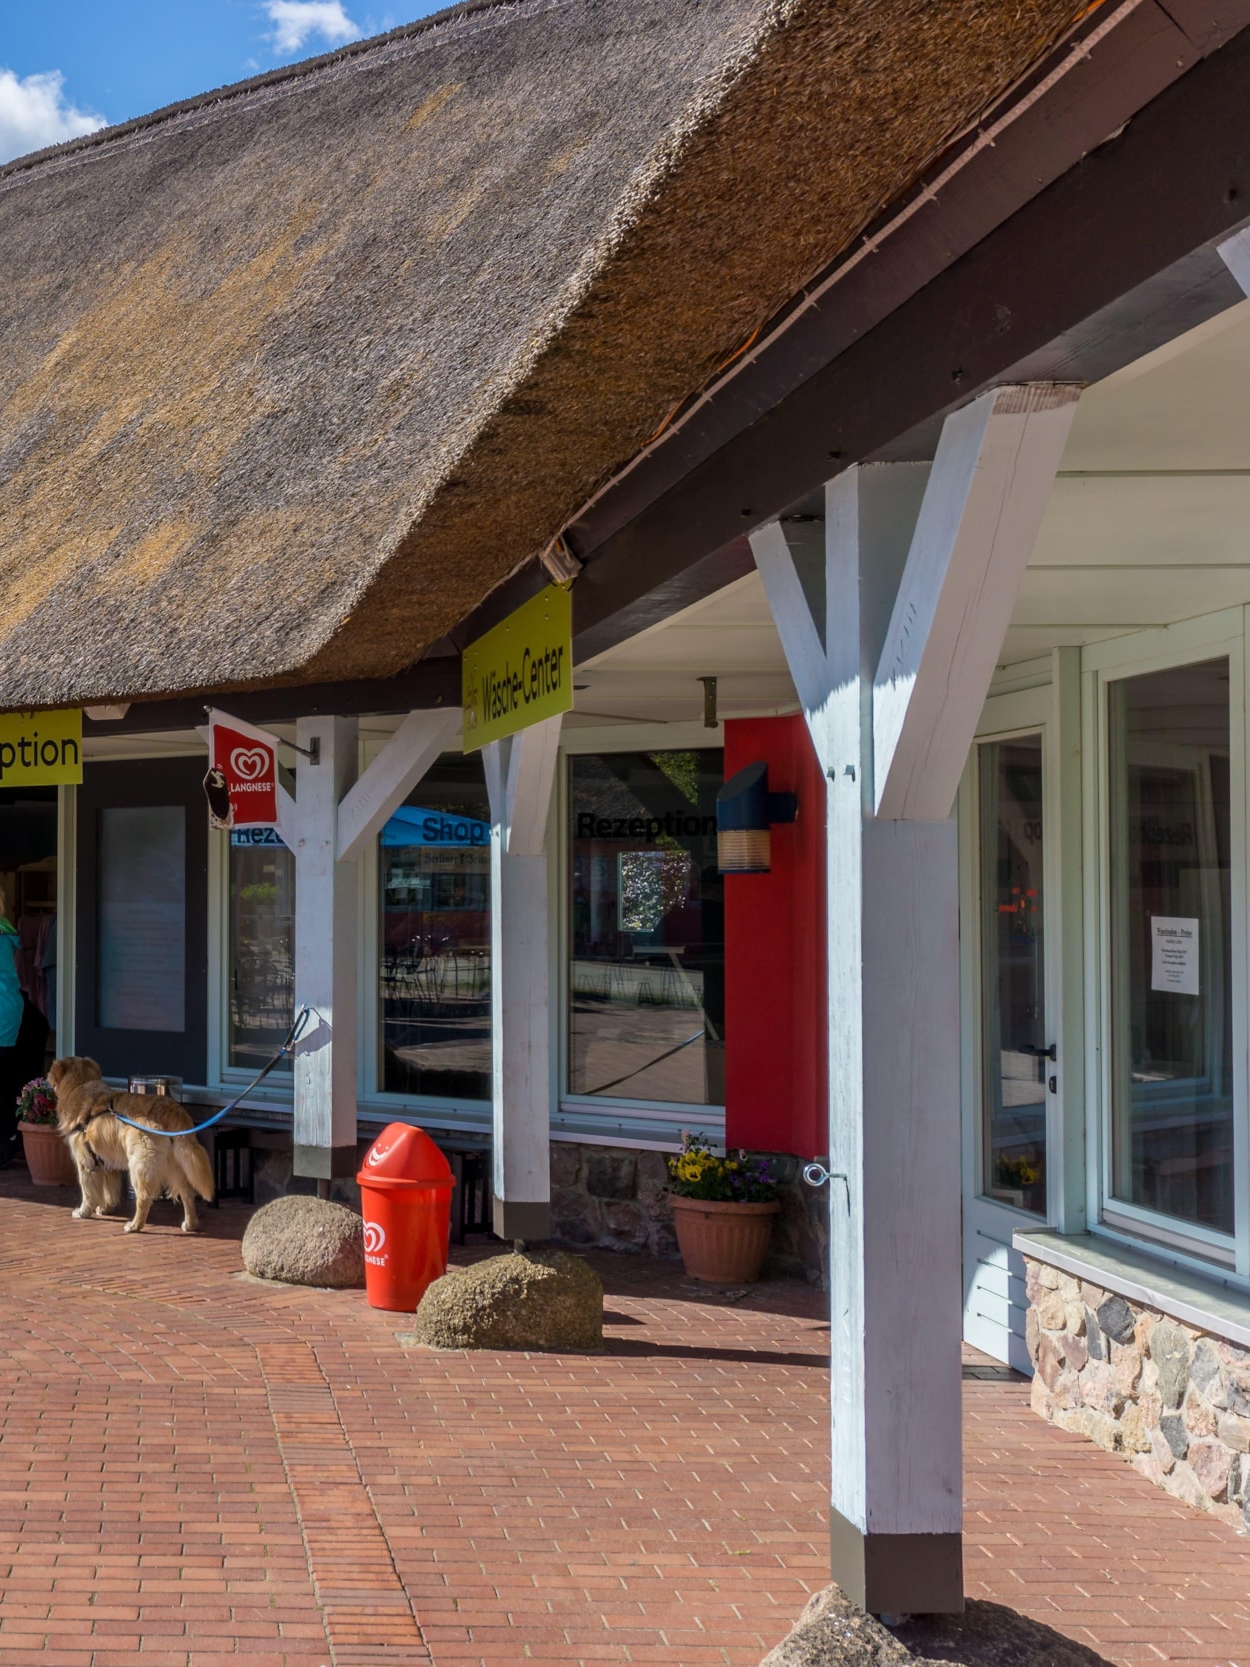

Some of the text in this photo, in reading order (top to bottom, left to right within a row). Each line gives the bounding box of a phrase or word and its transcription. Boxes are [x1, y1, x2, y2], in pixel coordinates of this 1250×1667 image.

[481, 646, 564, 724] Wäsche-Center
[230, 782, 271, 793] LANGNESE
[421, 817, 485, 846] Shop
[578, 811, 718, 842] Rezeption
